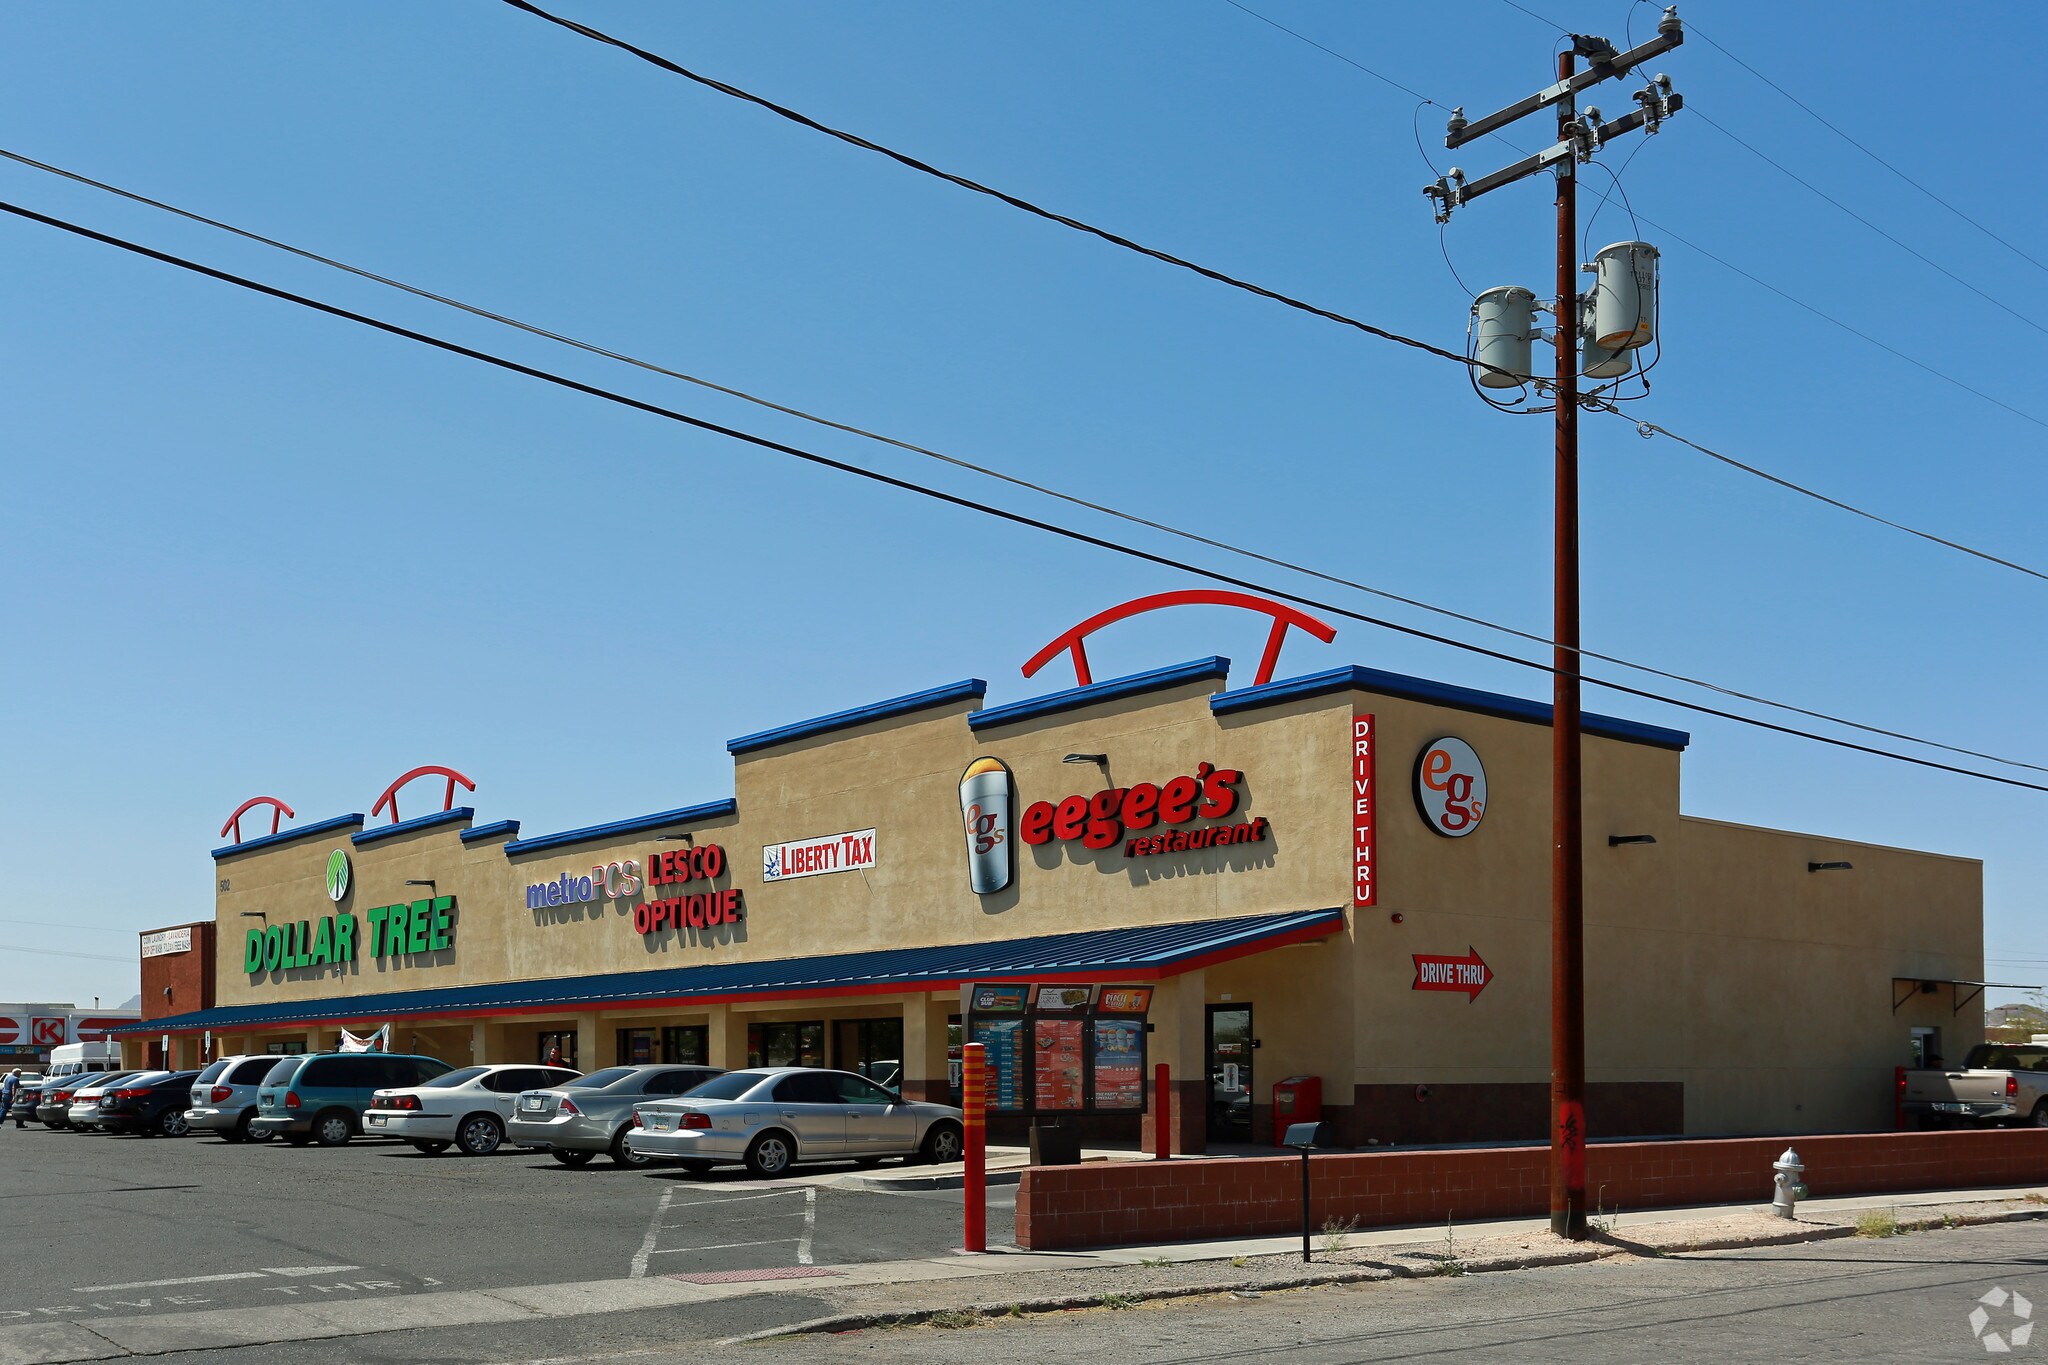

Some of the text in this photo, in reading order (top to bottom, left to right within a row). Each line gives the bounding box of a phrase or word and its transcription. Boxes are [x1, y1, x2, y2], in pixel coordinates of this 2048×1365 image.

[1020, 761, 1242, 849] eegee's
[1355, 720, 1371, 901] DRIVE THRU
[780, 835, 874, 876] LIBERTY TAX
[1123, 816, 1269, 858] restaurant
[219, 879, 231, 892] 502
[526, 860, 642, 909] metroPCS
[648, 843, 723, 886] LESCO
[633, 889, 743, 935] OPTIQUE
[244, 895, 456, 974] DOLLAR TREE
[1420, 962, 1485, 985] DRIVE THRU
[40, 1022, 62, 1044] K
[0, 1295, 211, 1319] DRIVE
